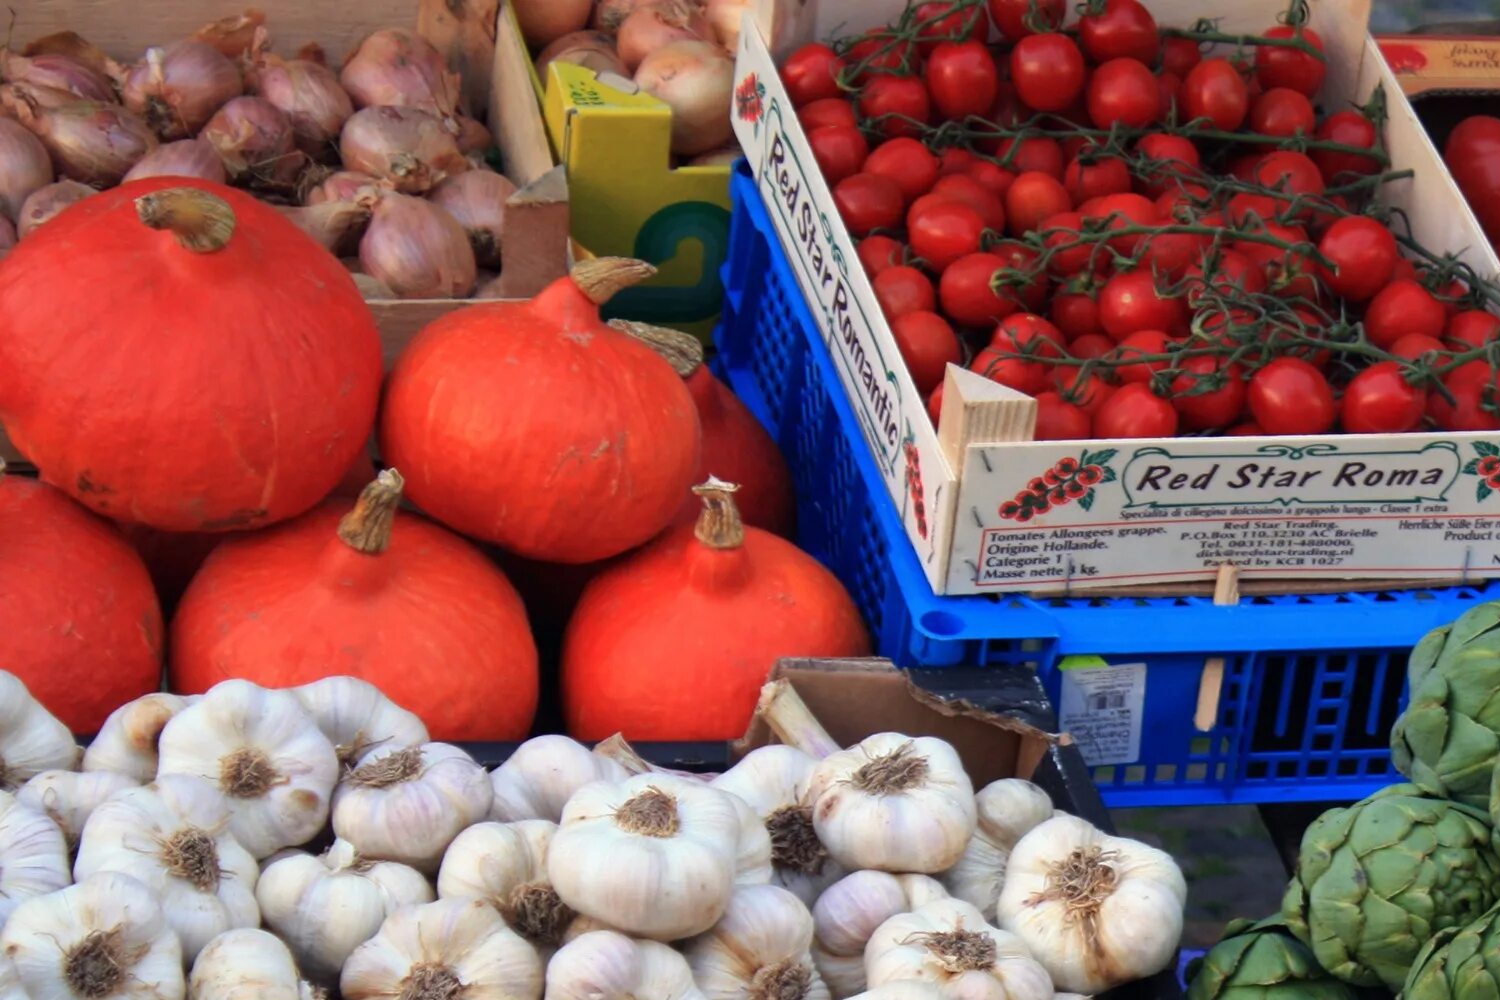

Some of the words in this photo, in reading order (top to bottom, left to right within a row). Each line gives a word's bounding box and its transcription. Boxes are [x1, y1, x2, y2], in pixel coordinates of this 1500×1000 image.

[769, 132, 800, 210] Red
[797, 201, 832, 290] Star
[832, 280, 899, 447] Romantic
[1136, 463, 1221, 492] Red
[1228, 462, 1321, 489] Star
[1333, 461, 1445, 488] Roma
[1380, 503, 1412, 514] Classe
[1224, 521, 1250, 530] Red
[1254, 521, 1280, 530] Star
[1285, 520, 1338, 531] Trading.
[989, 532, 1045, 542] Tomates
[1117, 527, 1167, 538] grappe.
[1181, 532, 1237, 541] P.O.Box
[1309, 530, 1327, 539] AC
[1335, 528, 1378, 538] Brielle
[1444, 530, 1493, 541] Product
[987, 543, 1039, 556] Origine
[1043, 539, 1108, 551] Hollande.
[1201, 540, 1223, 549] Tel.
[986, 555, 1051, 567] Categorie
[1256, 558, 1270, 567] by
[1311, 557, 1344, 566] 1027
[984, 569, 1026, 580] Masse
[1029, 567, 1064, 577] nette
[1080, 564, 1099, 576] kg.
